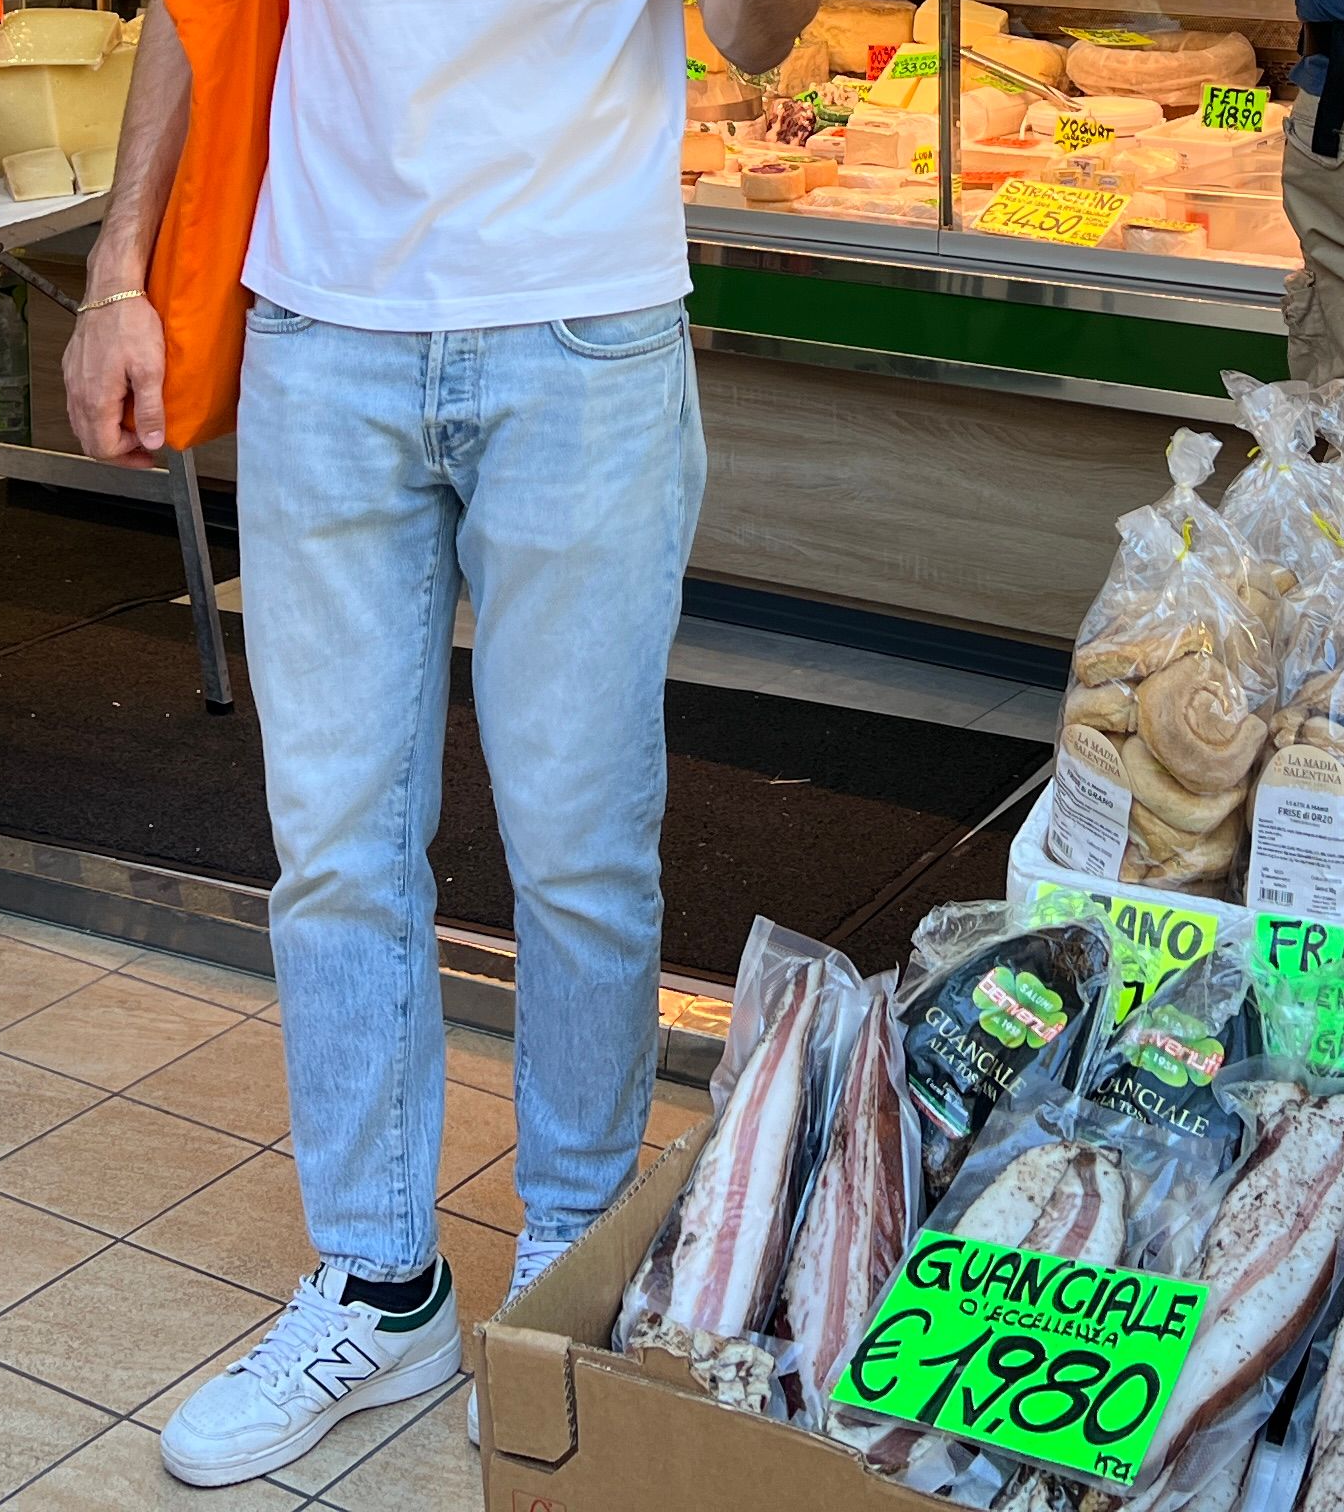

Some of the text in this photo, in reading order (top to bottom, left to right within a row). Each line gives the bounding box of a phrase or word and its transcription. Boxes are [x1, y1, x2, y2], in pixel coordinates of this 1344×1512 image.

[1209, 87, 1256, 109] FETA
[1059, 116, 1115, 140] YOGURT
[1005, 180, 1124, 212] STRACCHINO
[1073, 742, 1122, 779] SALENTINA
[1077, 731, 1119, 767] LA MADIA
[1287, 753, 1339, 774] LA MADIA
[1282, 764, 1342, 786] SALENTINA
[924, 1005, 1029, 1099] GUANCIALE
[905, 1238, 1199, 1341] GUANCIALE
[304, 1337, 381, 1401] N
